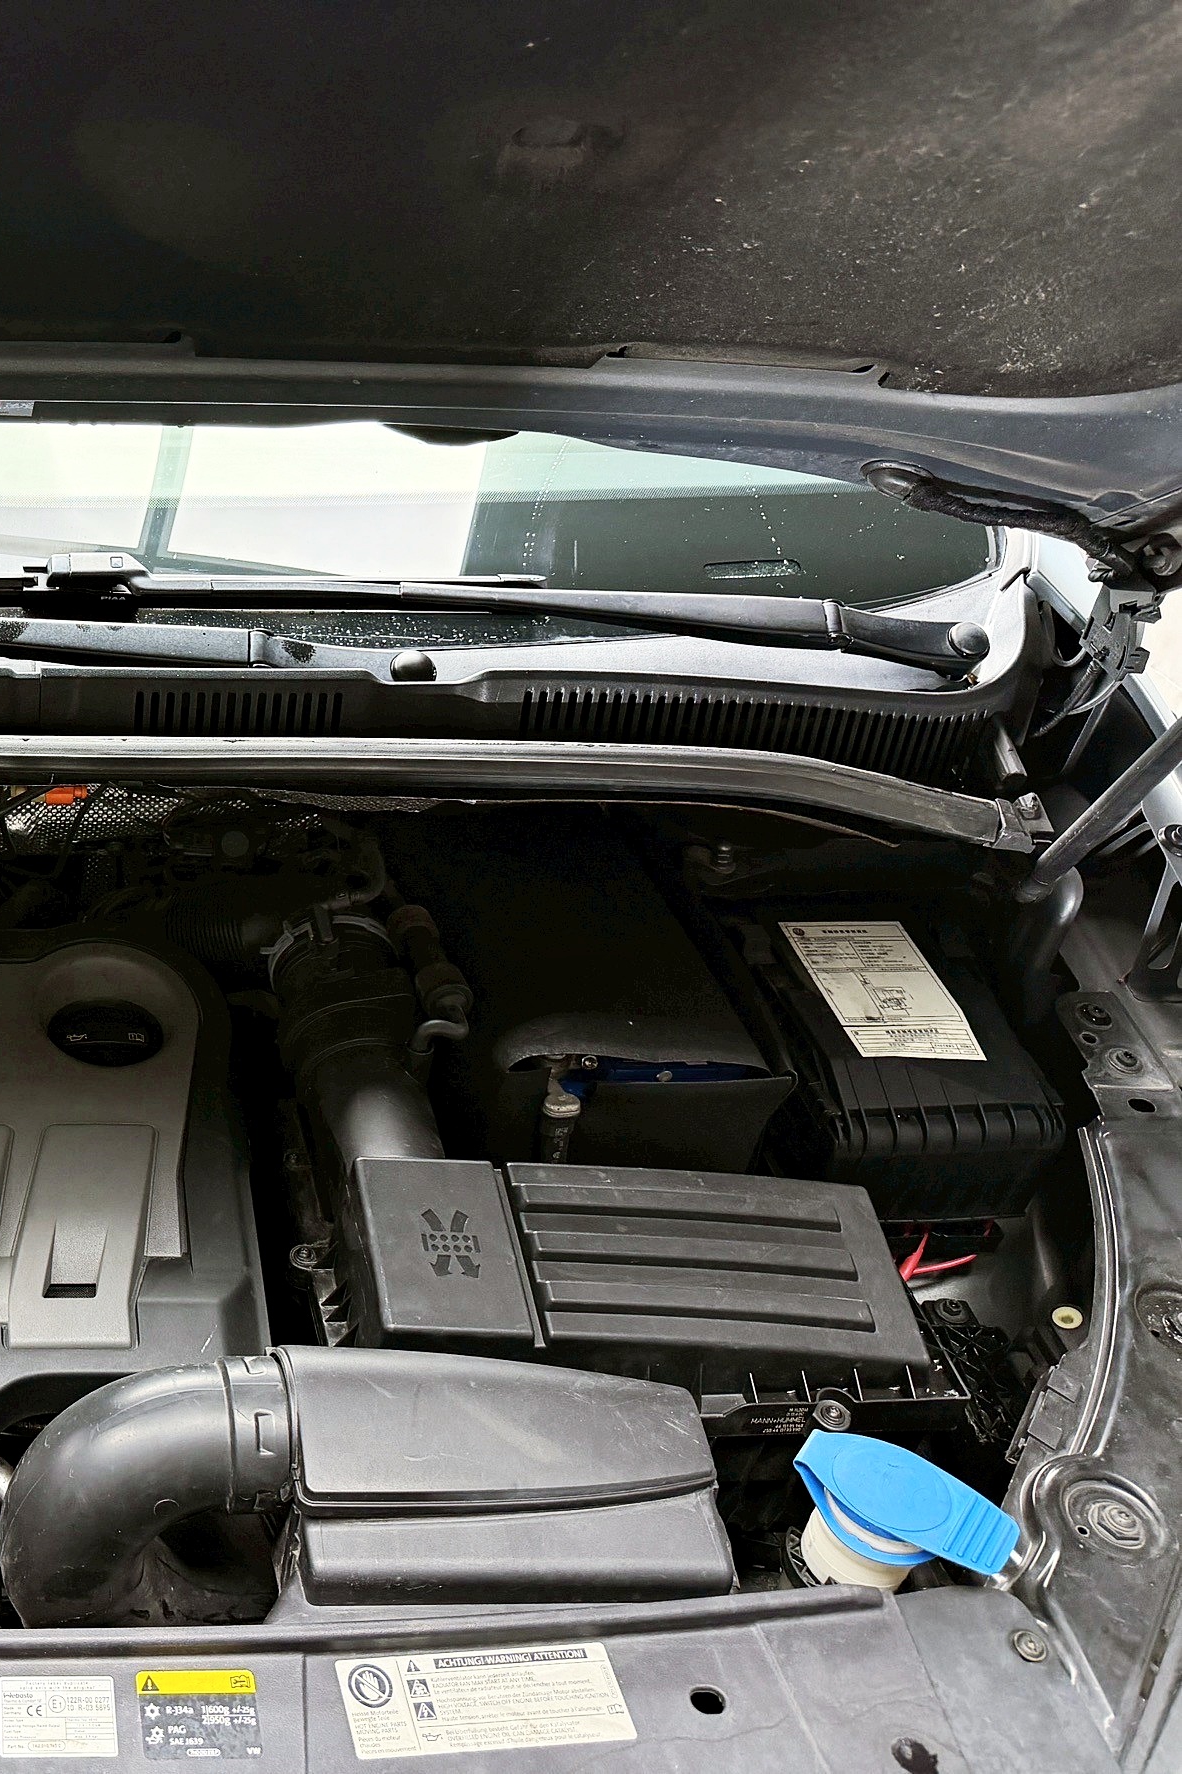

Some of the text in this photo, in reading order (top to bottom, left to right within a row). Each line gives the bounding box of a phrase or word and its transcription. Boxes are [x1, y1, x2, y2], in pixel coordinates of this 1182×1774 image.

[438, 1649, 585, 1668] ACHTUNG! WARNING! ATTENTION!
[26, 1705, 43, 1717] CE
[168, 1725, 187, 1734] PAG
[169, 1737, 185, 1746] SAE
[246, 1746, 261, 1755] VW
